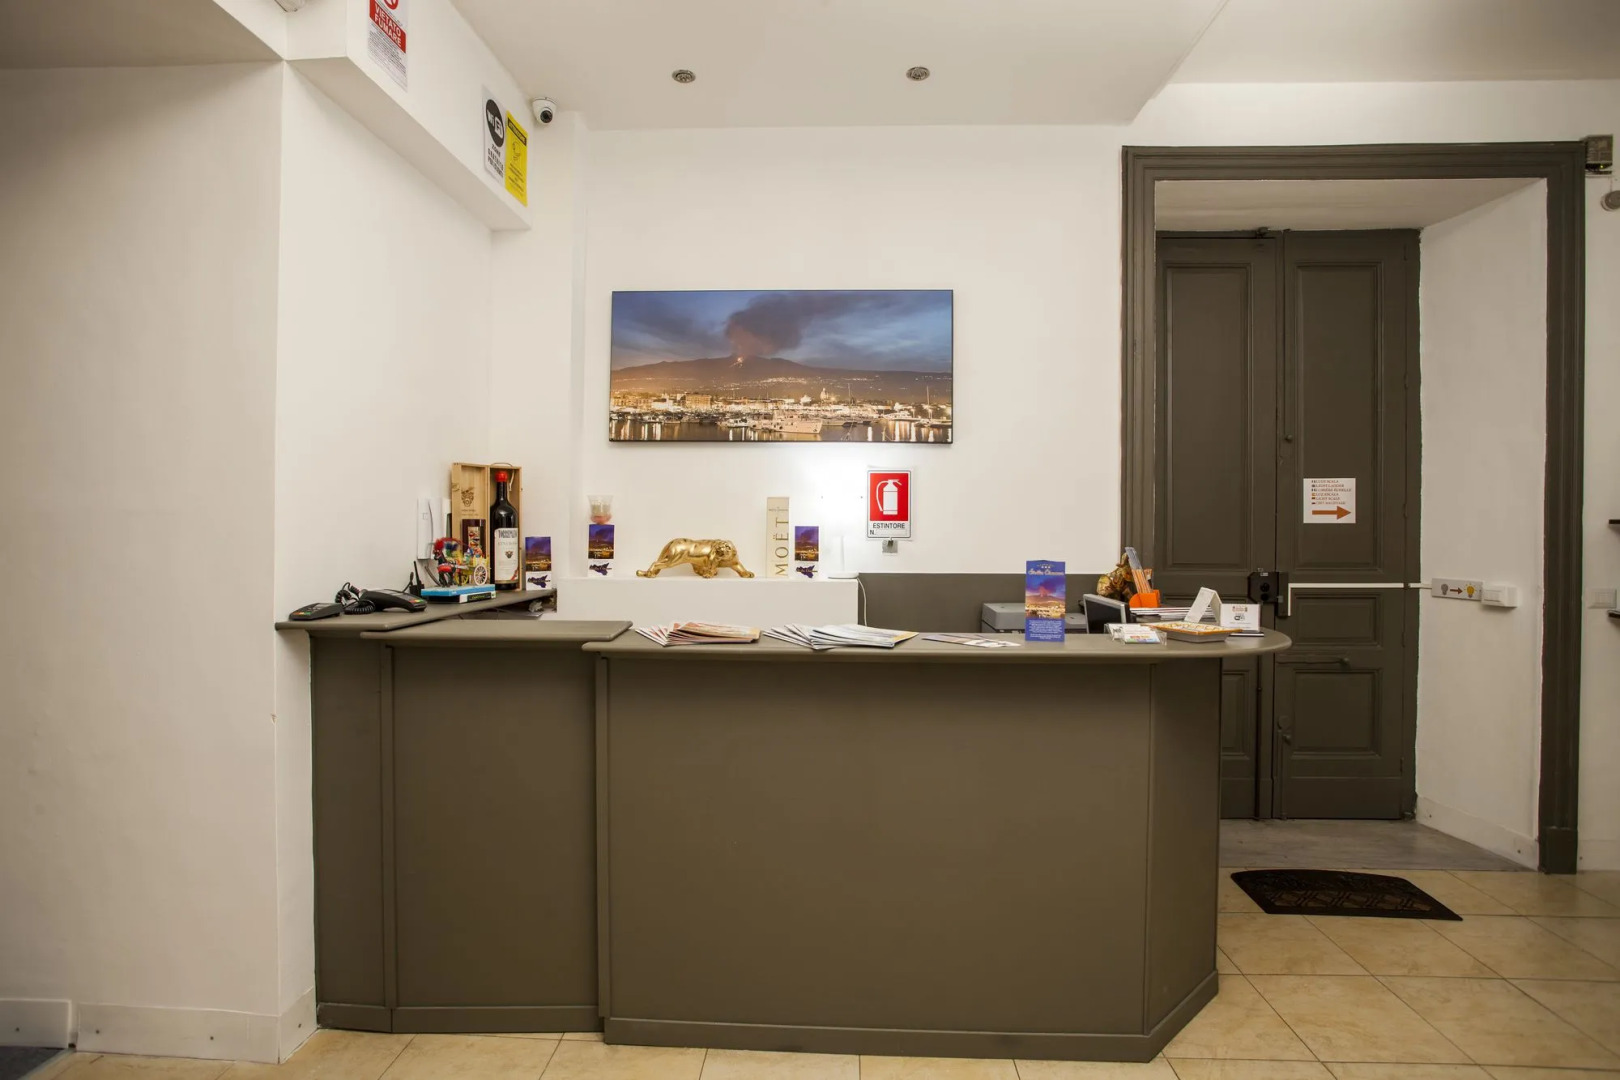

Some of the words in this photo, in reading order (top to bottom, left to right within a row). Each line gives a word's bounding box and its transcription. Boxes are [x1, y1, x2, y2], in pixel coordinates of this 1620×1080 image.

[374, 2, 402, 37] VIETATO
[374, 12, 402, 48] FUMARE
[772, 517, 789, 576] MOËT
